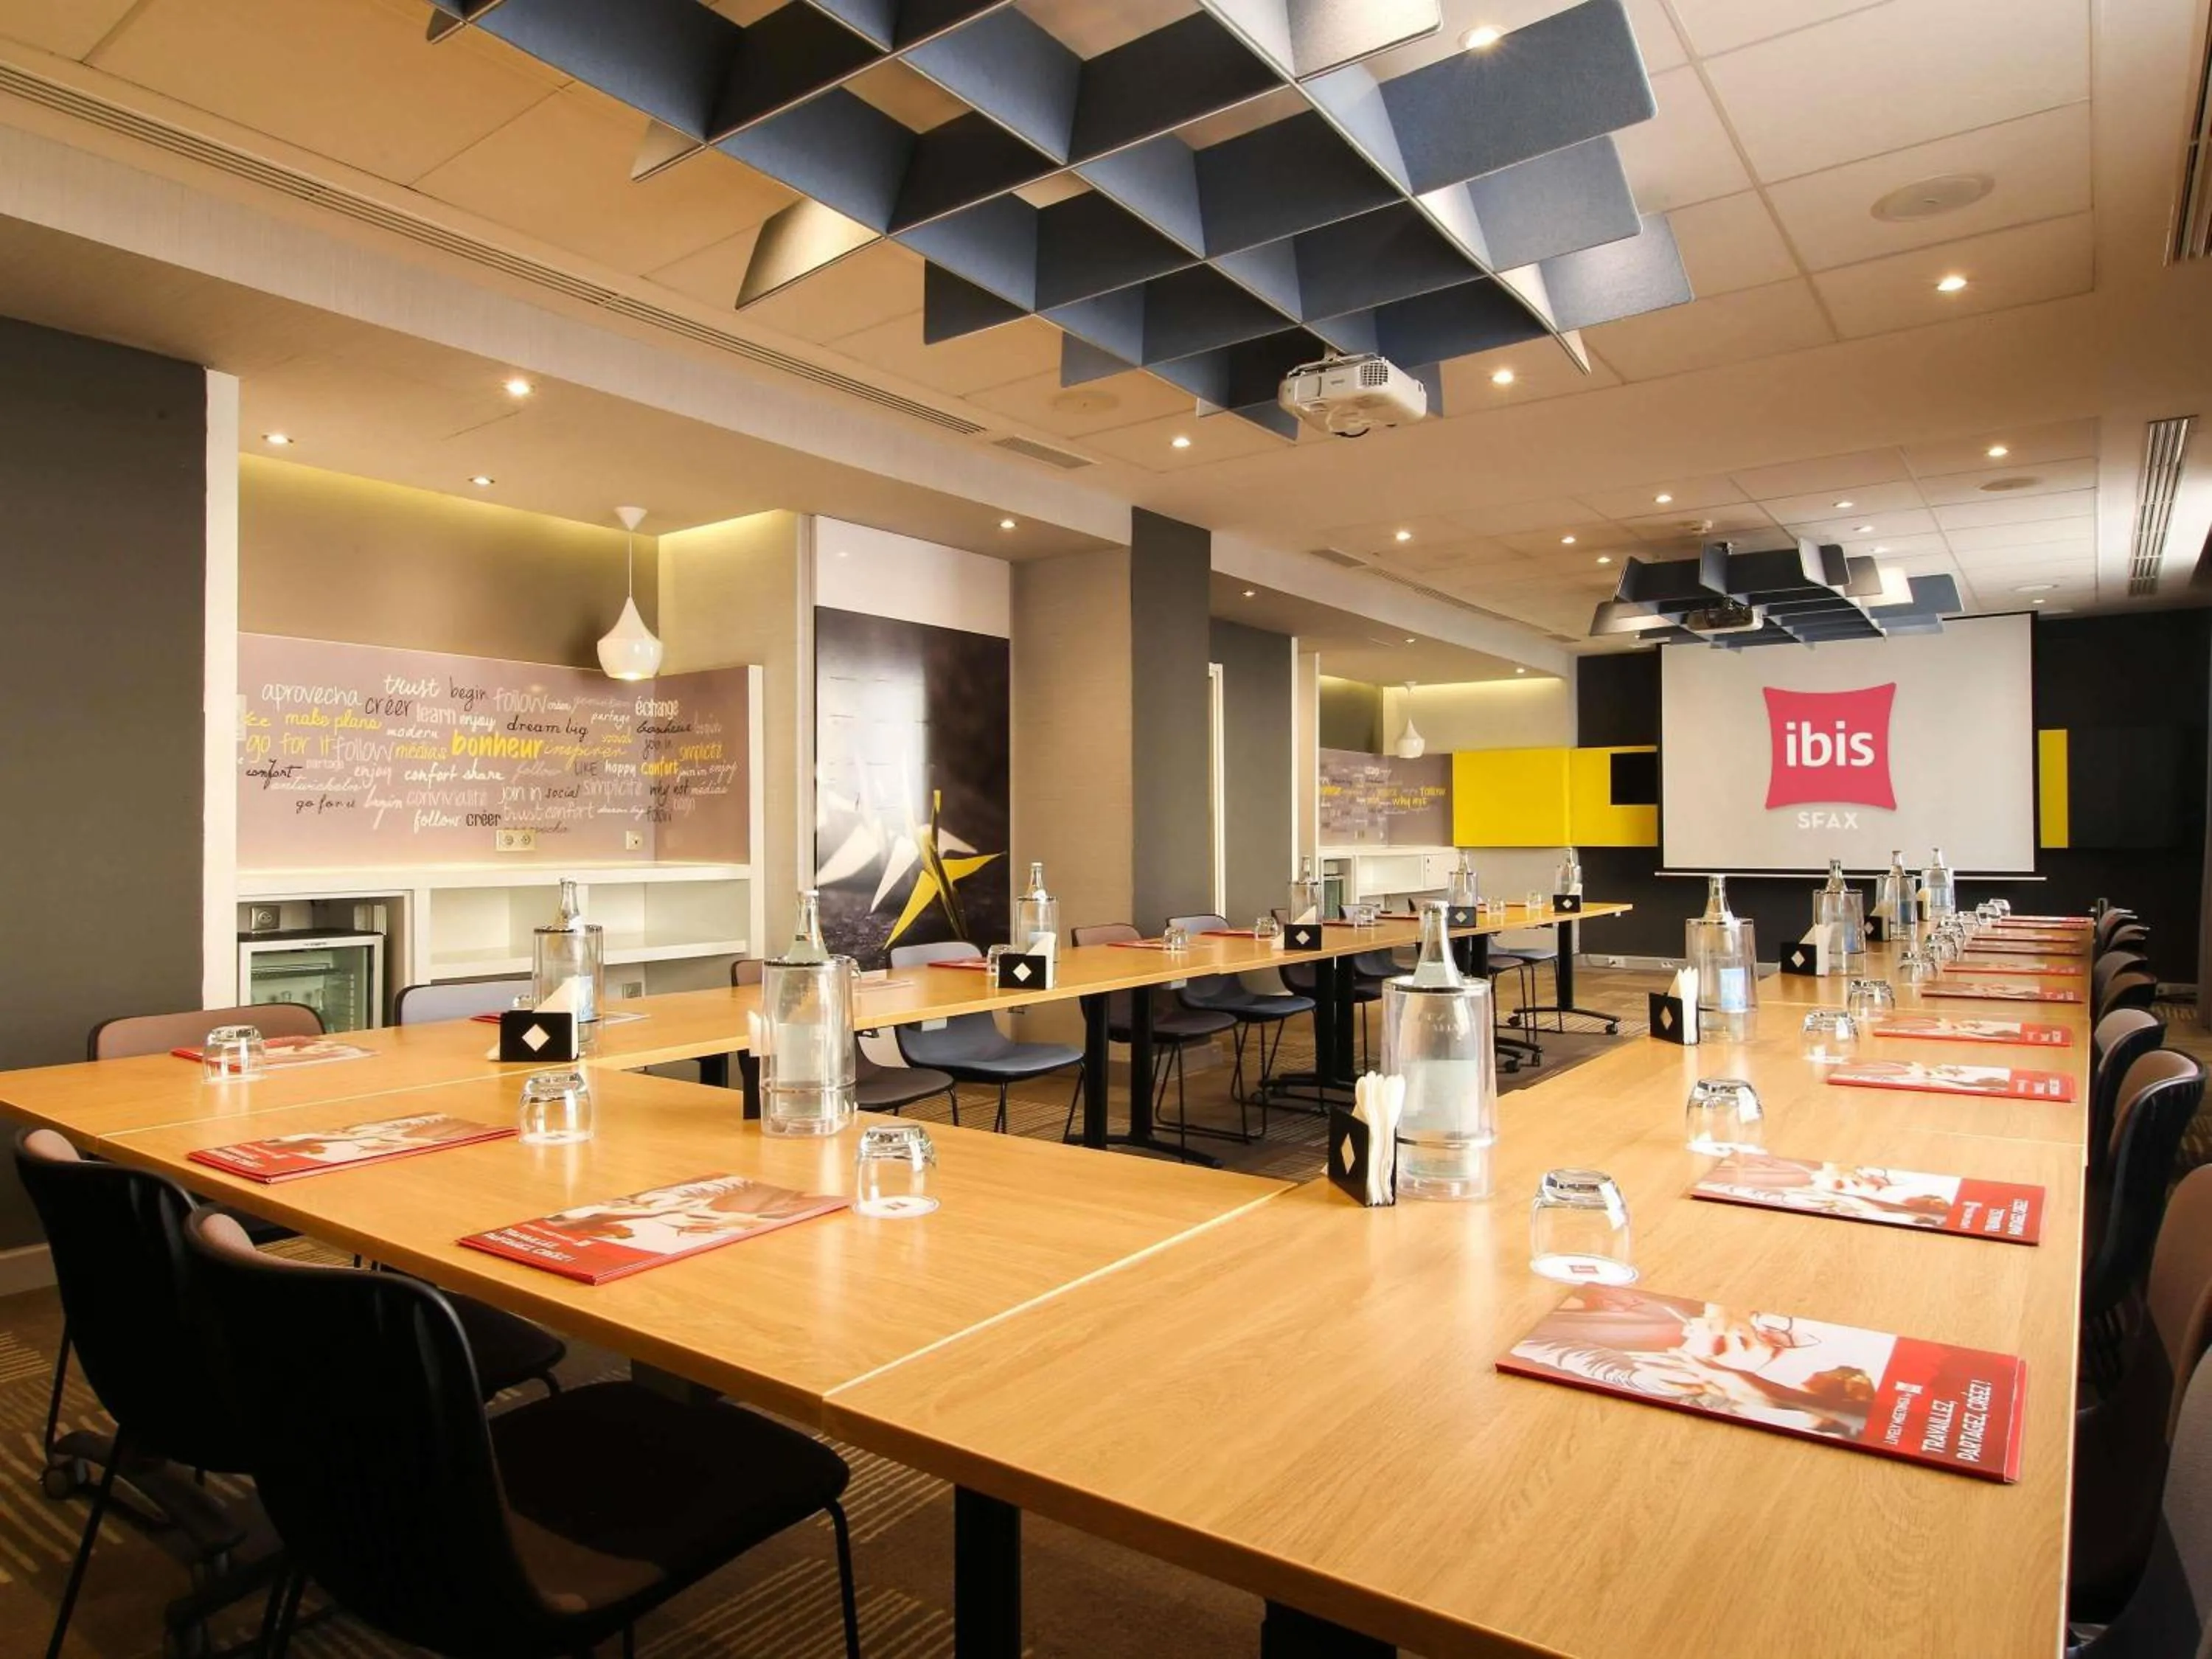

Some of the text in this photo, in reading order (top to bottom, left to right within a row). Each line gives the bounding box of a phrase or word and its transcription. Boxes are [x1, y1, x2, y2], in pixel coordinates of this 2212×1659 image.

[261, 684, 361, 712] aprovecha
[384, 674, 440, 698] trust
[449, 675, 487, 712] begin
[493, 686, 549, 713] follow
[365, 695, 413, 717] créer
[417, 702, 456, 725] learn
[636, 695, 679, 720] échange
[507, 714, 588, 742] dream big
[246, 734, 271, 763] go
[279, 732, 310, 755] for
[333, 737, 395, 764] follow
[451, 728, 543, 759] bonheur
[1787, 720, 1875, 767] ibis
[605, 759, 636, 777] happy
[414, 810, 459, 834] follow
[1798, 813, 1858, 829] SFAX
